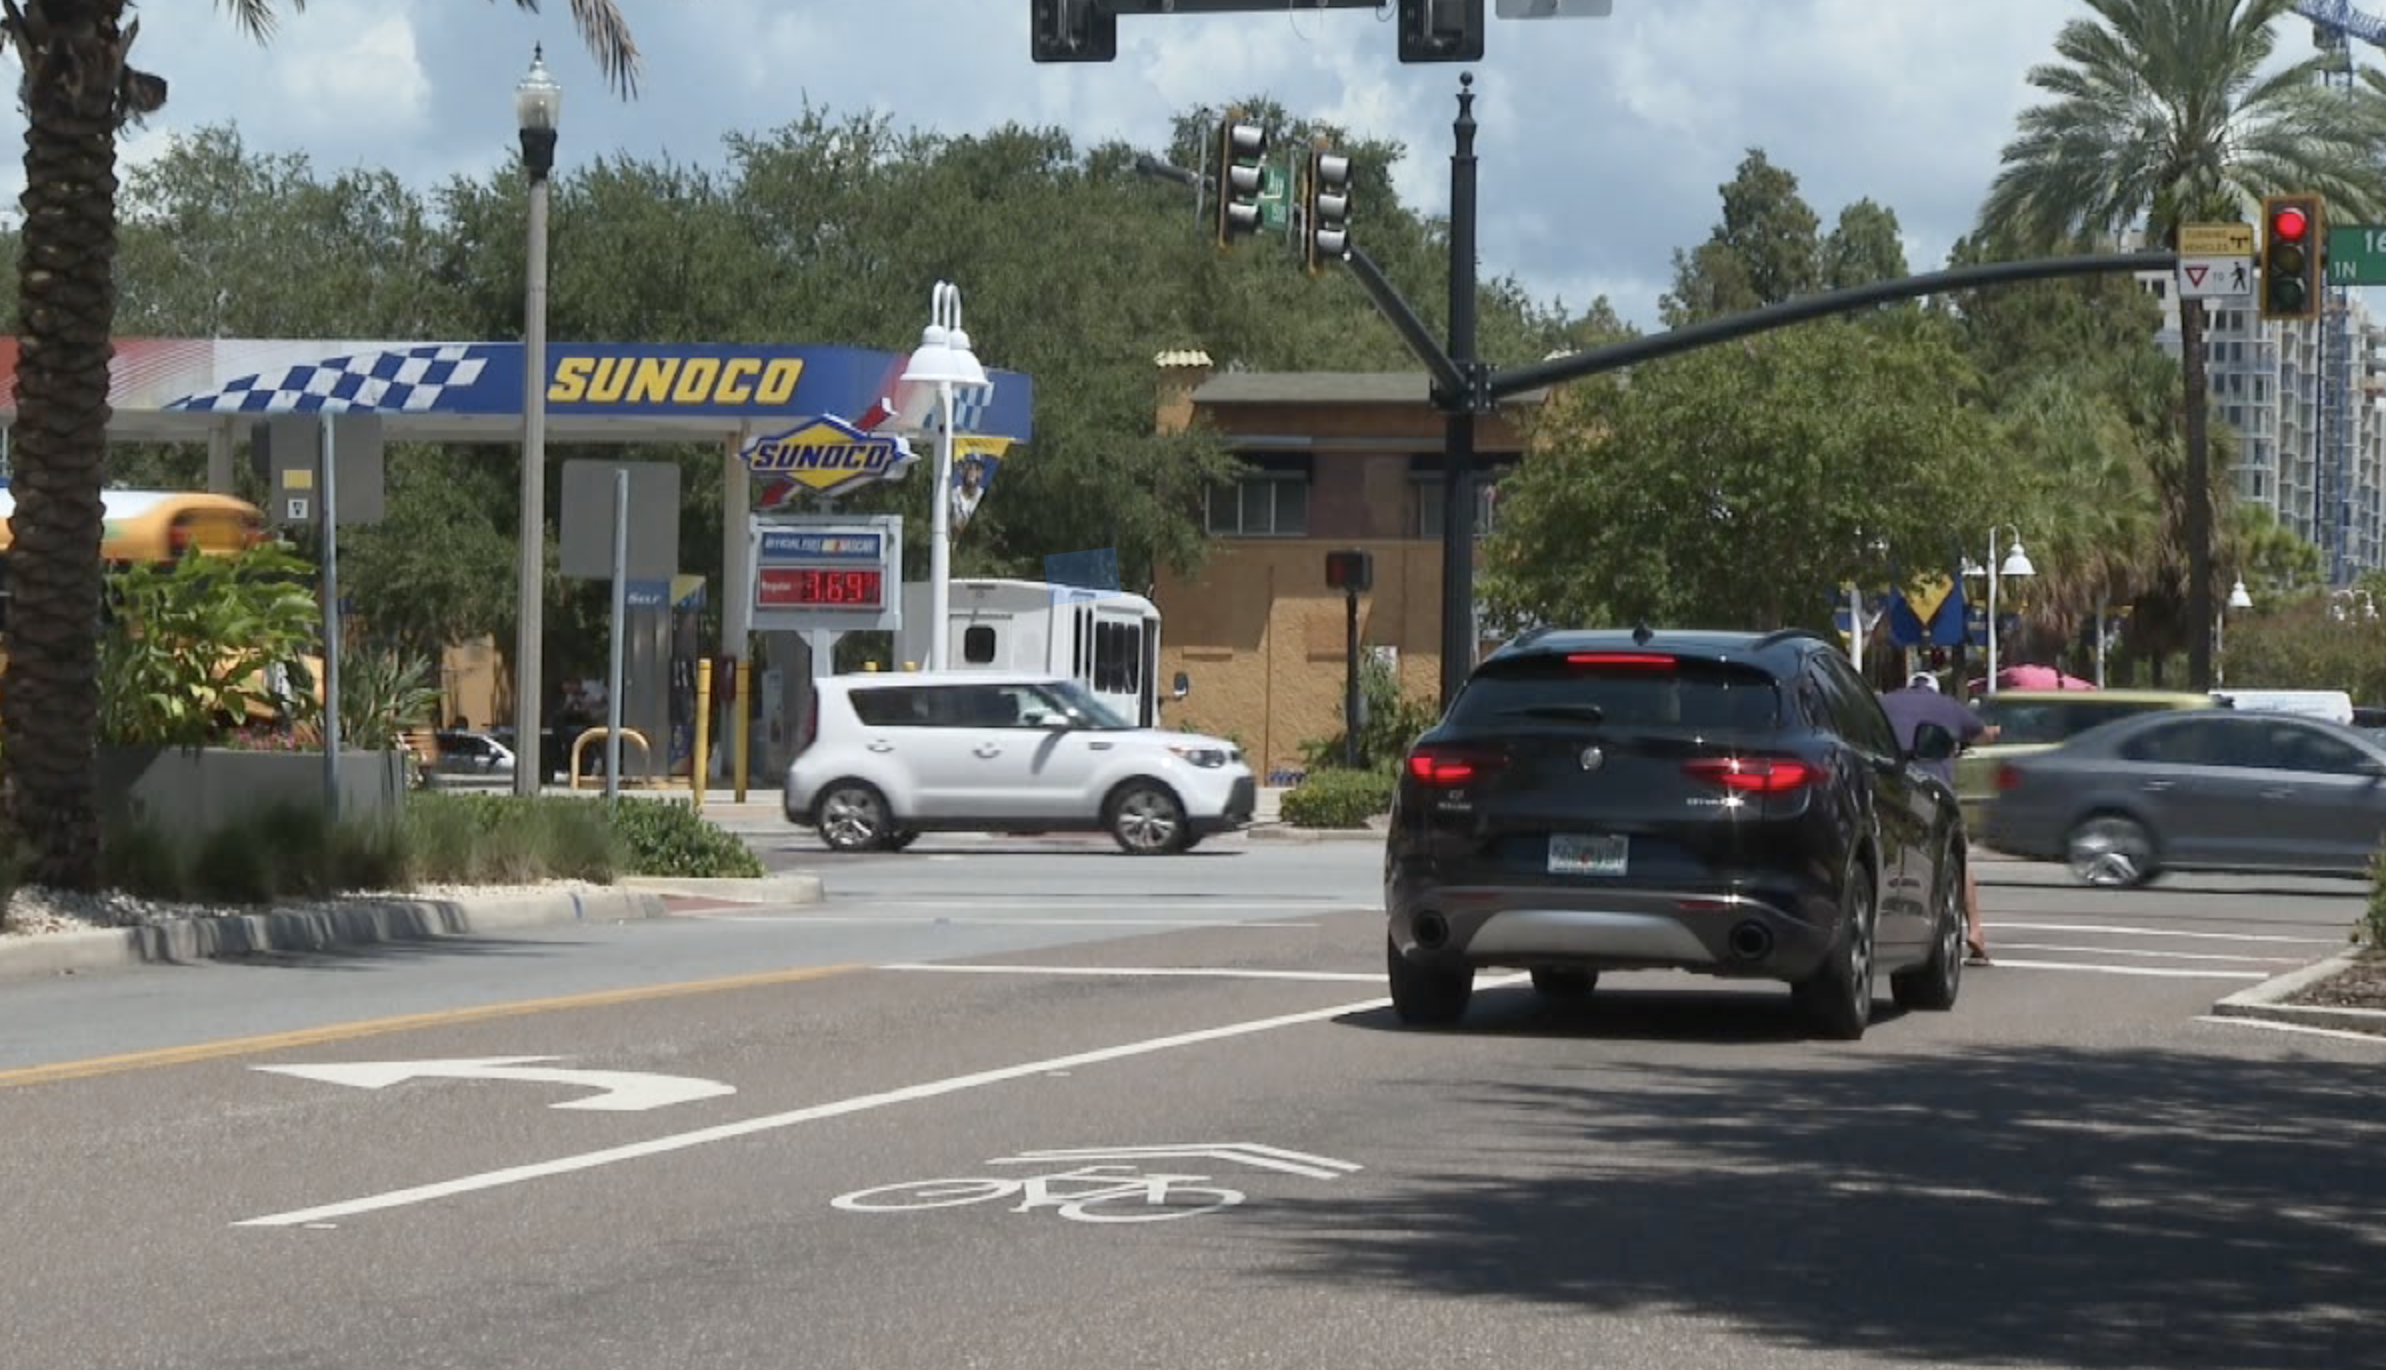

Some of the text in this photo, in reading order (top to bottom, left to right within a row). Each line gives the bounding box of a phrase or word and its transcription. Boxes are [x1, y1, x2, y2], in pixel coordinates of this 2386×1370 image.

[2184, 242, 2229, 252] VEHICLES
[547, 357, 804, 404] SUNOCO
[754, 443, 890, 470] SUNOCO
